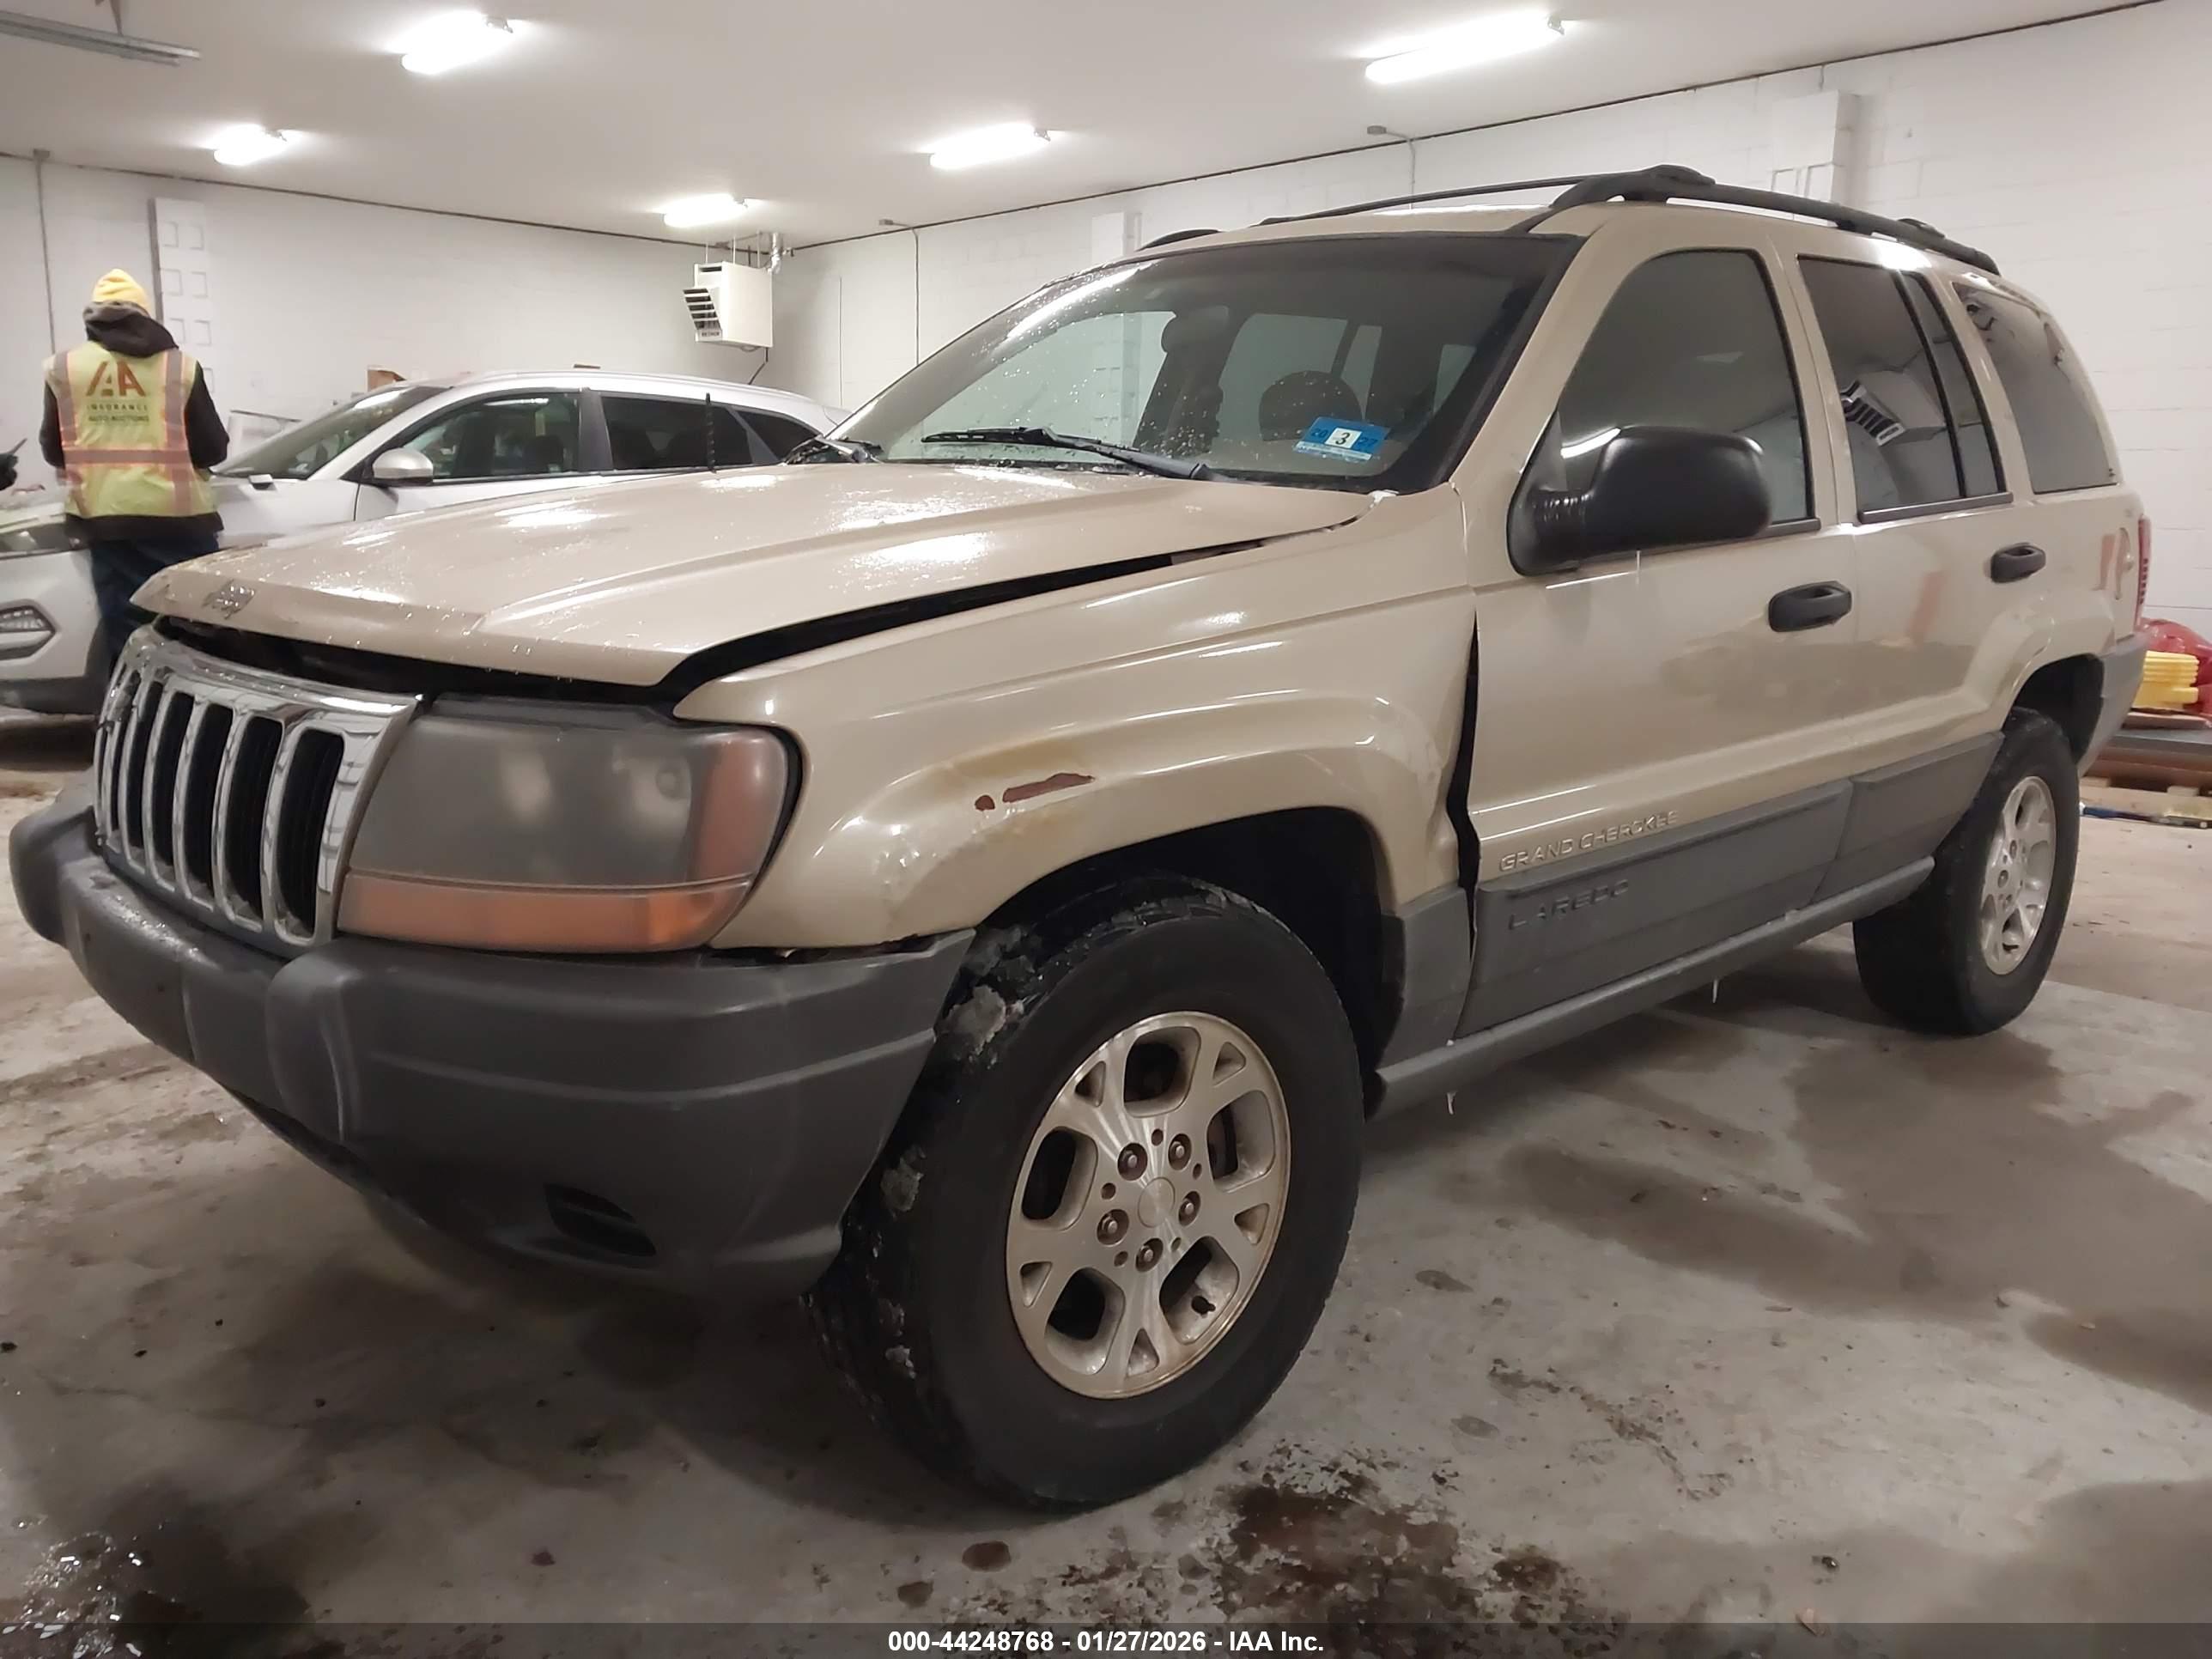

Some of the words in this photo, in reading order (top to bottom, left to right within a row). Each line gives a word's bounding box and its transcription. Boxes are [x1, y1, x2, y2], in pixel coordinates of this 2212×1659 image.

[1335, 432, 1350, 445] 3
[1499, 838, 1573, 872] GRAND
[1579, 810, 1678, 851] CHEROKEE
[1507, 878, 1629, 931] LAREDO
